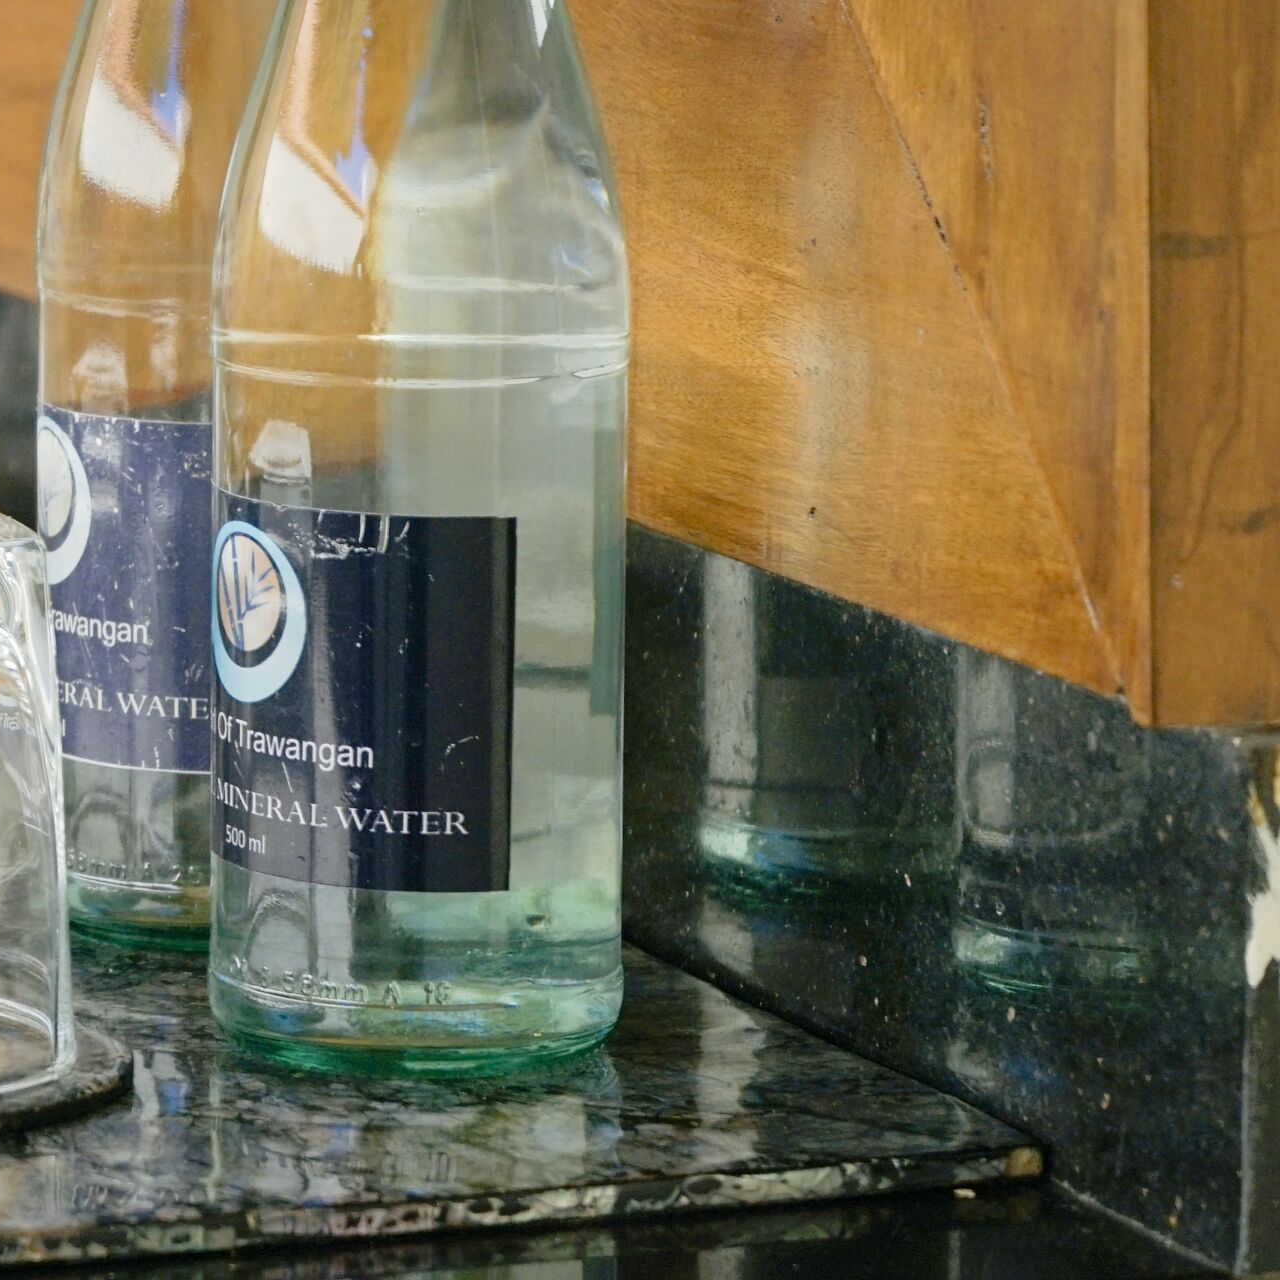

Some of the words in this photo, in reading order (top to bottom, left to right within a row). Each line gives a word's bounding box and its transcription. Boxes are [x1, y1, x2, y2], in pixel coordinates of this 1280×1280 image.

[217, 711, 233, 743] Of
[235, 718, 374, 772] Trawangan
[216, 777, 328, 827] MINERAL
[335, 806, 469, 835] WATER
[225, 824, 247, 849] 500
[248, 834, 266, 855] ml
